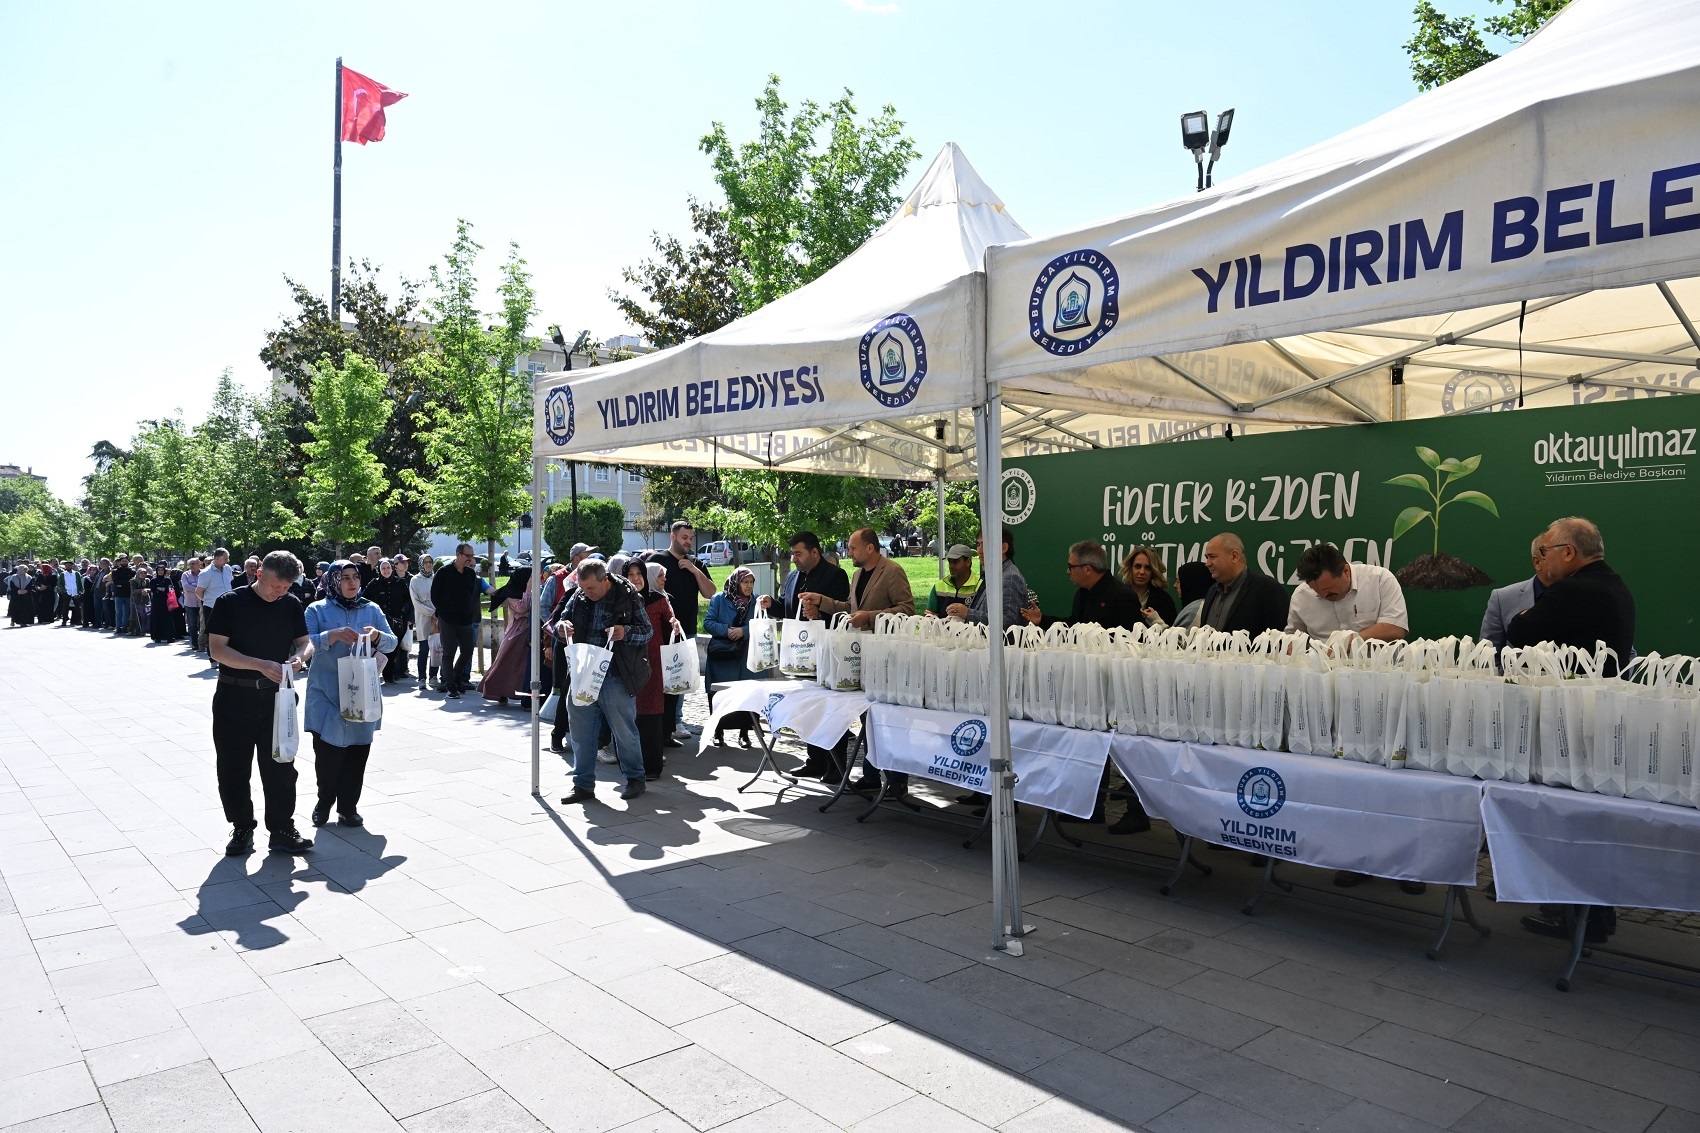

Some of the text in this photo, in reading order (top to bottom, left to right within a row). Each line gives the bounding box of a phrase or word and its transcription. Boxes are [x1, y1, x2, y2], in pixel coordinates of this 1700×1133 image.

[1192, 162, 1700, 314] YILDIRIM BELE
[1031, 252, 1115, 318] BURSA YILDIRIM
[861, 316, 923, 371] BURSA YILDIRIM
[1032, 312, 1116, 353] BELEDİYESİ
[597, 365, 824, 430] YILDIRIM BELEDİYESİ
[865, 370, 925, 405] BELEDİYESİ
[1534, 430, 1604, 470] oktay
[1545, 467, 1686, 483] Yıldırım Belediye Başkanı
[928, 766, 984, 787] BELEDİYESİ
[933, 755, 988, 777] YILDIRIM
[1238, 768, 1284, 796] BURSA YILDIRIM
[1219, 818, 1297, 844] YILDIRIM
[1220, 833, 1297, 857] BELEDİYESİ
